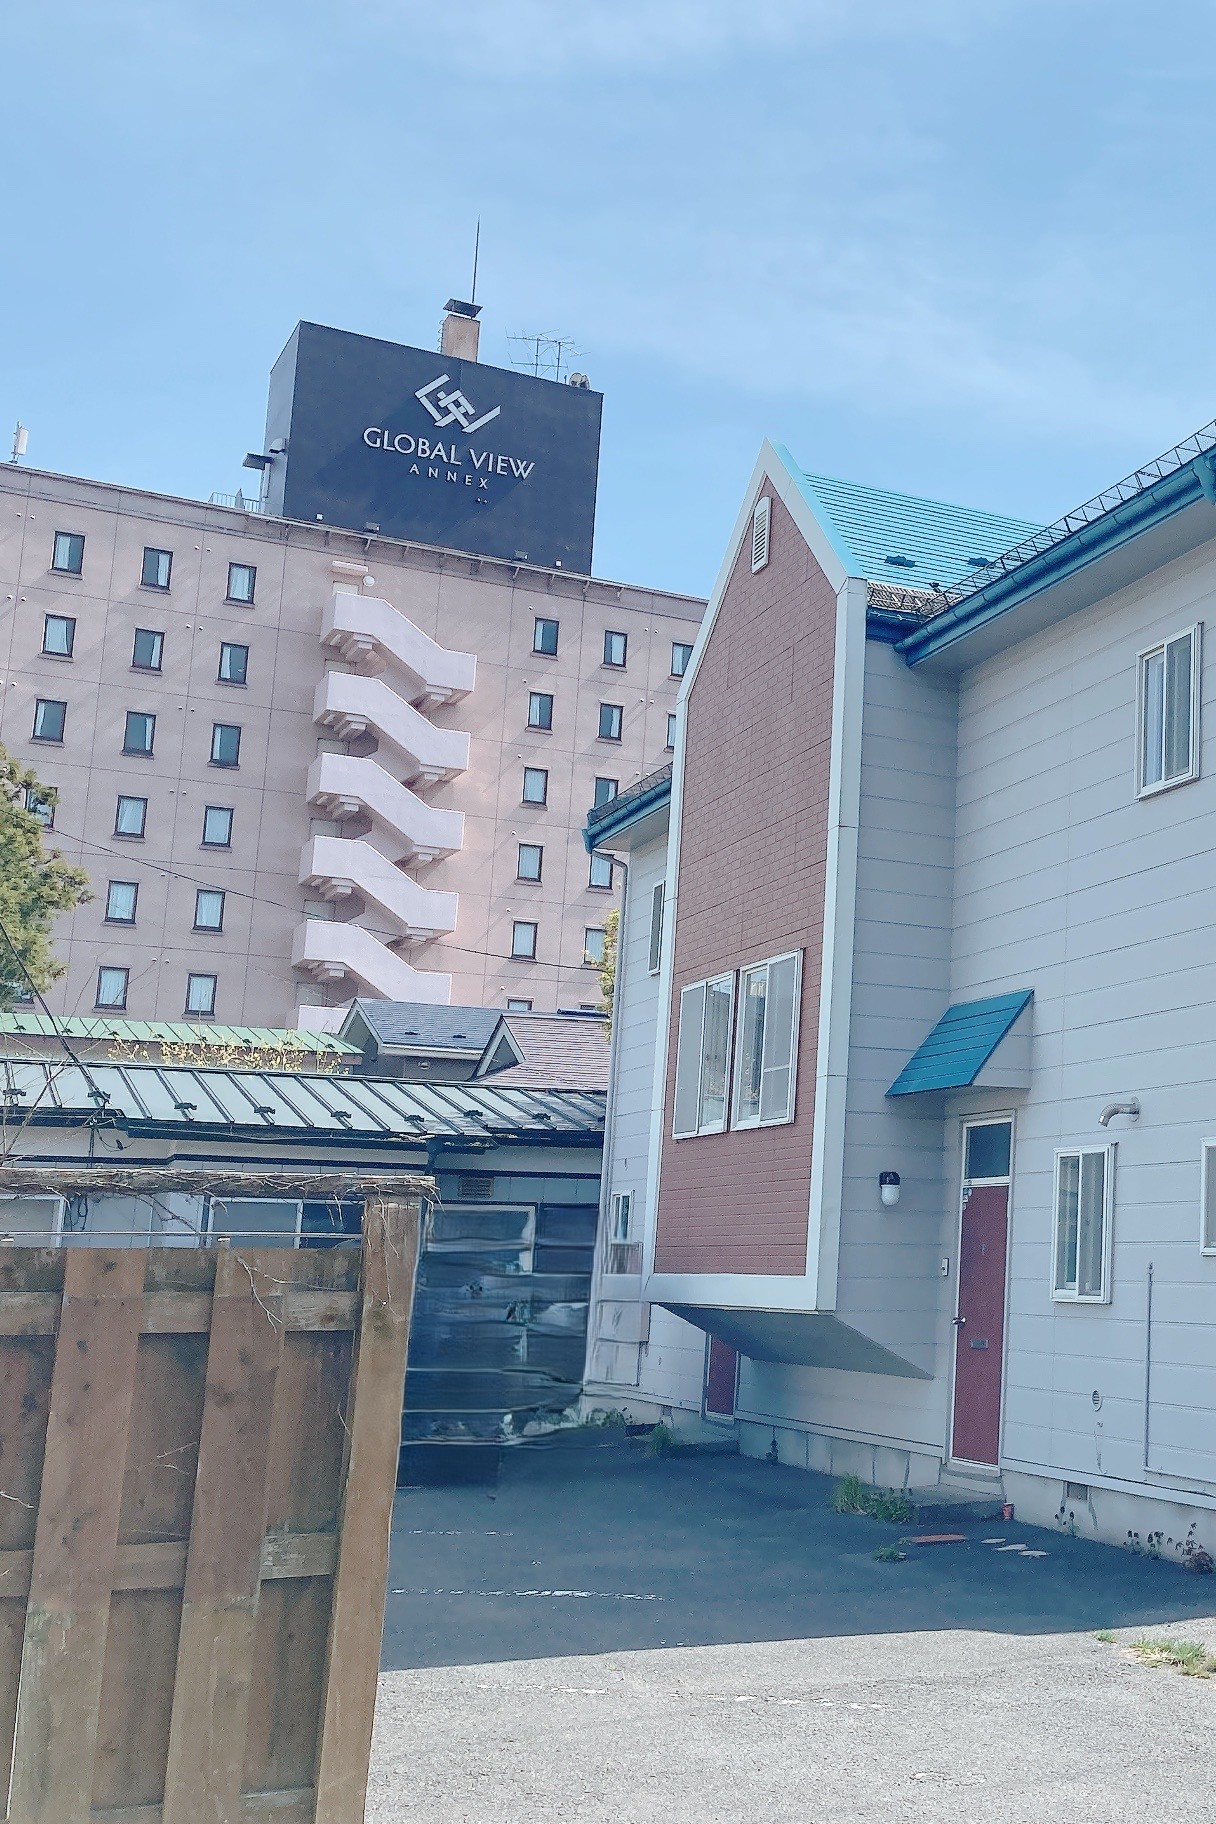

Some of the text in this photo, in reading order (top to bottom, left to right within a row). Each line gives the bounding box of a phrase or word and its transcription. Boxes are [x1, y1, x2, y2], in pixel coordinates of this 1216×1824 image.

[363, 427, 536, 480] GLOBAL VIEW
[409, 463, 489, 490] ANNEX
